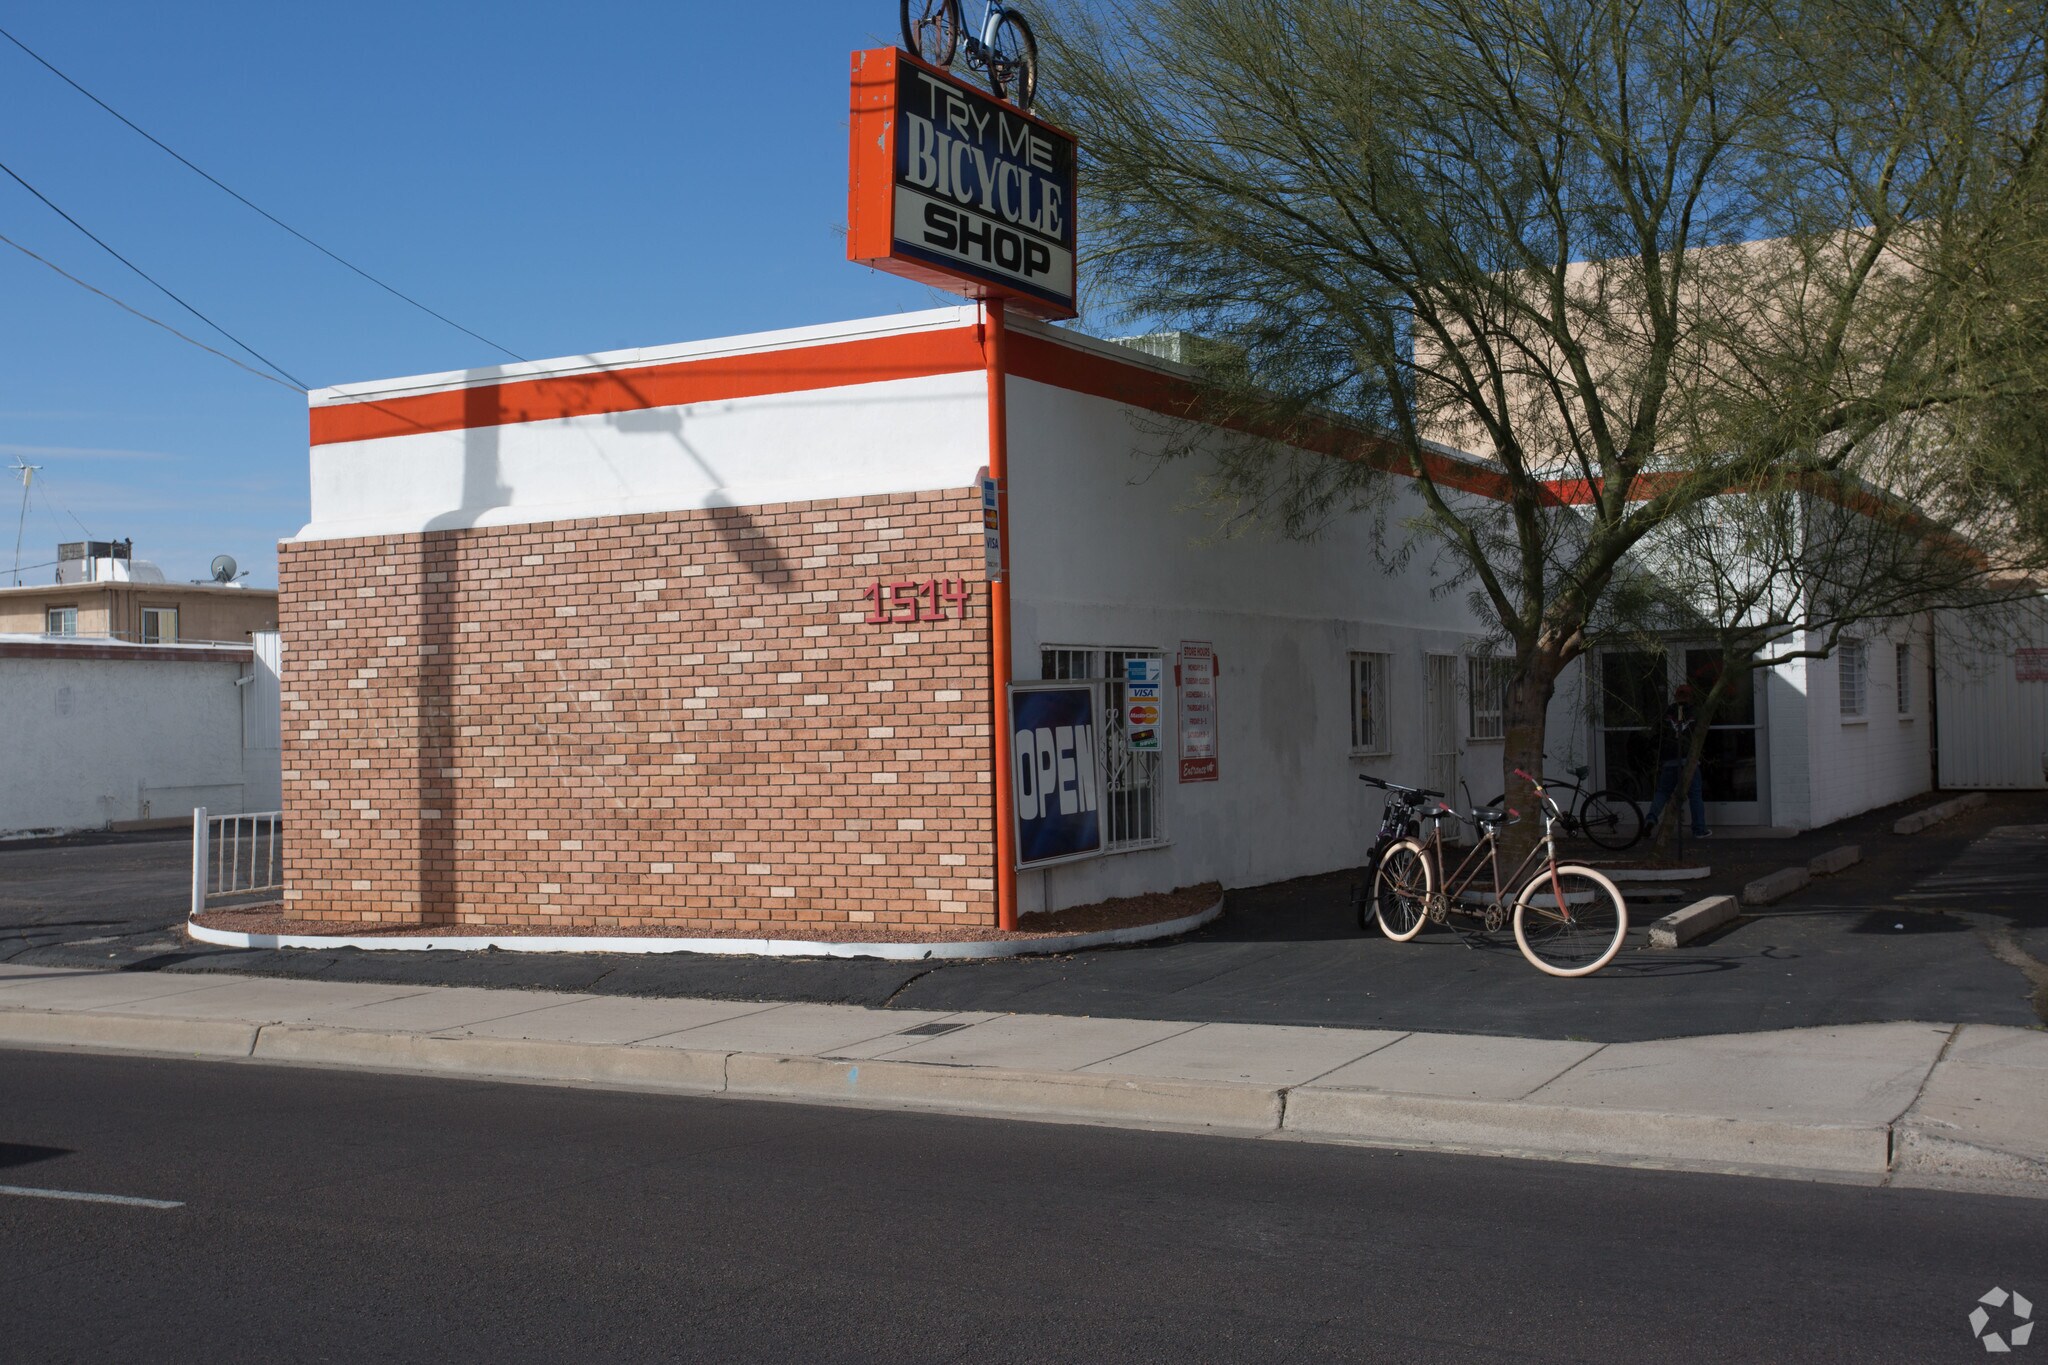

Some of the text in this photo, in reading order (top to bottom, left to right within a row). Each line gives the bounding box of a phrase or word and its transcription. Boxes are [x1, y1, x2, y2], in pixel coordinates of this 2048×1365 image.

[917, 71, 1053, 173] TRY ME
[905, 111, 1063, 240] BICYCLE
[923, 202, 1051, 278] SHOP
[986, 537, 999, 549] VISA
[863, 578, 968, 623] 1514
[1134, 689, 1153, 697] VISA
[1015, 724, 1097, 820] OPEN
